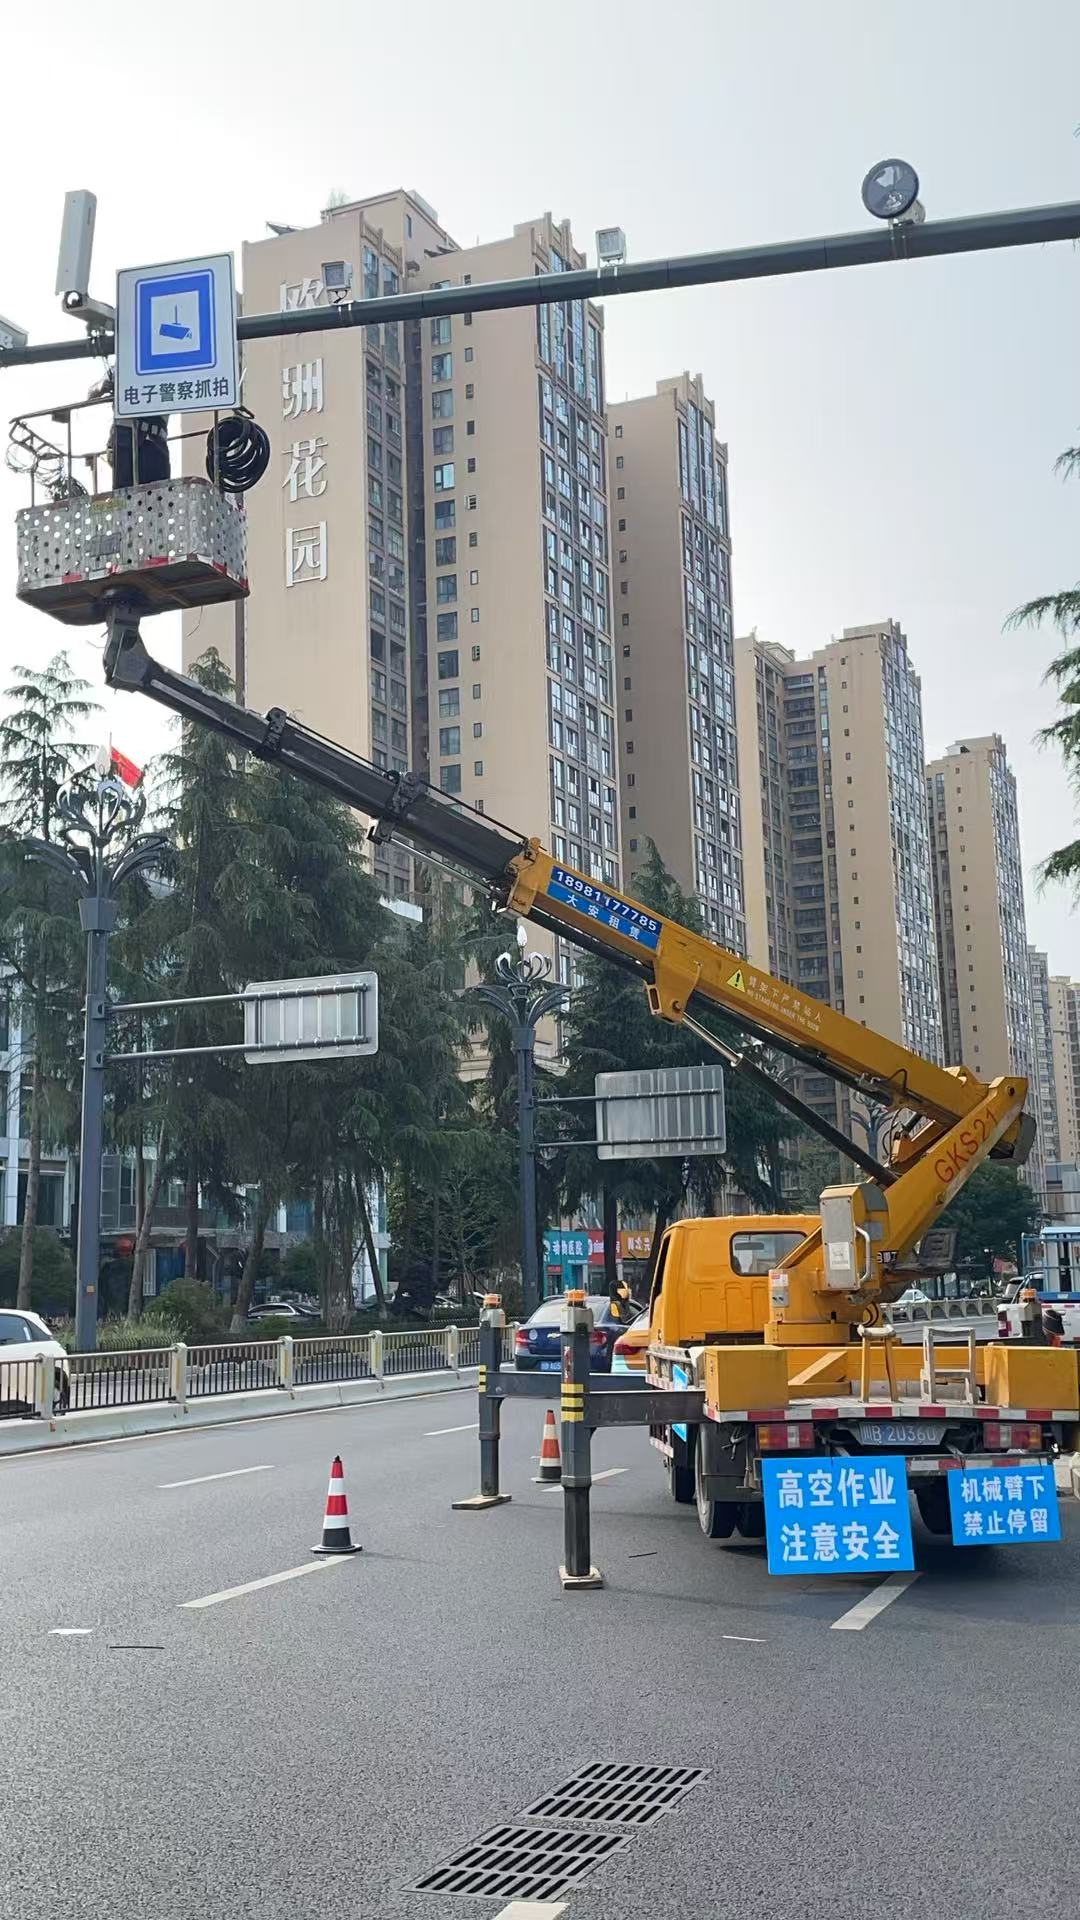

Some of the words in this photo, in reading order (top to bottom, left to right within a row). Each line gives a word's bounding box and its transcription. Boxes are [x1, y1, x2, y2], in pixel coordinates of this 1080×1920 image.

[124, 376, 229, 405] 电子警察抓拍
[556, 871, 657, 931] 18981177785
[935, 1106, 998, 1183] GKS21
[776, 1468, 897, 1508] 高空作业
[961, 1475, 1044, 1503] 机械臂下
[780, 1520, 900, 1562] 注意安全
[963, 1508, 1048, 1536] 禁止停留
